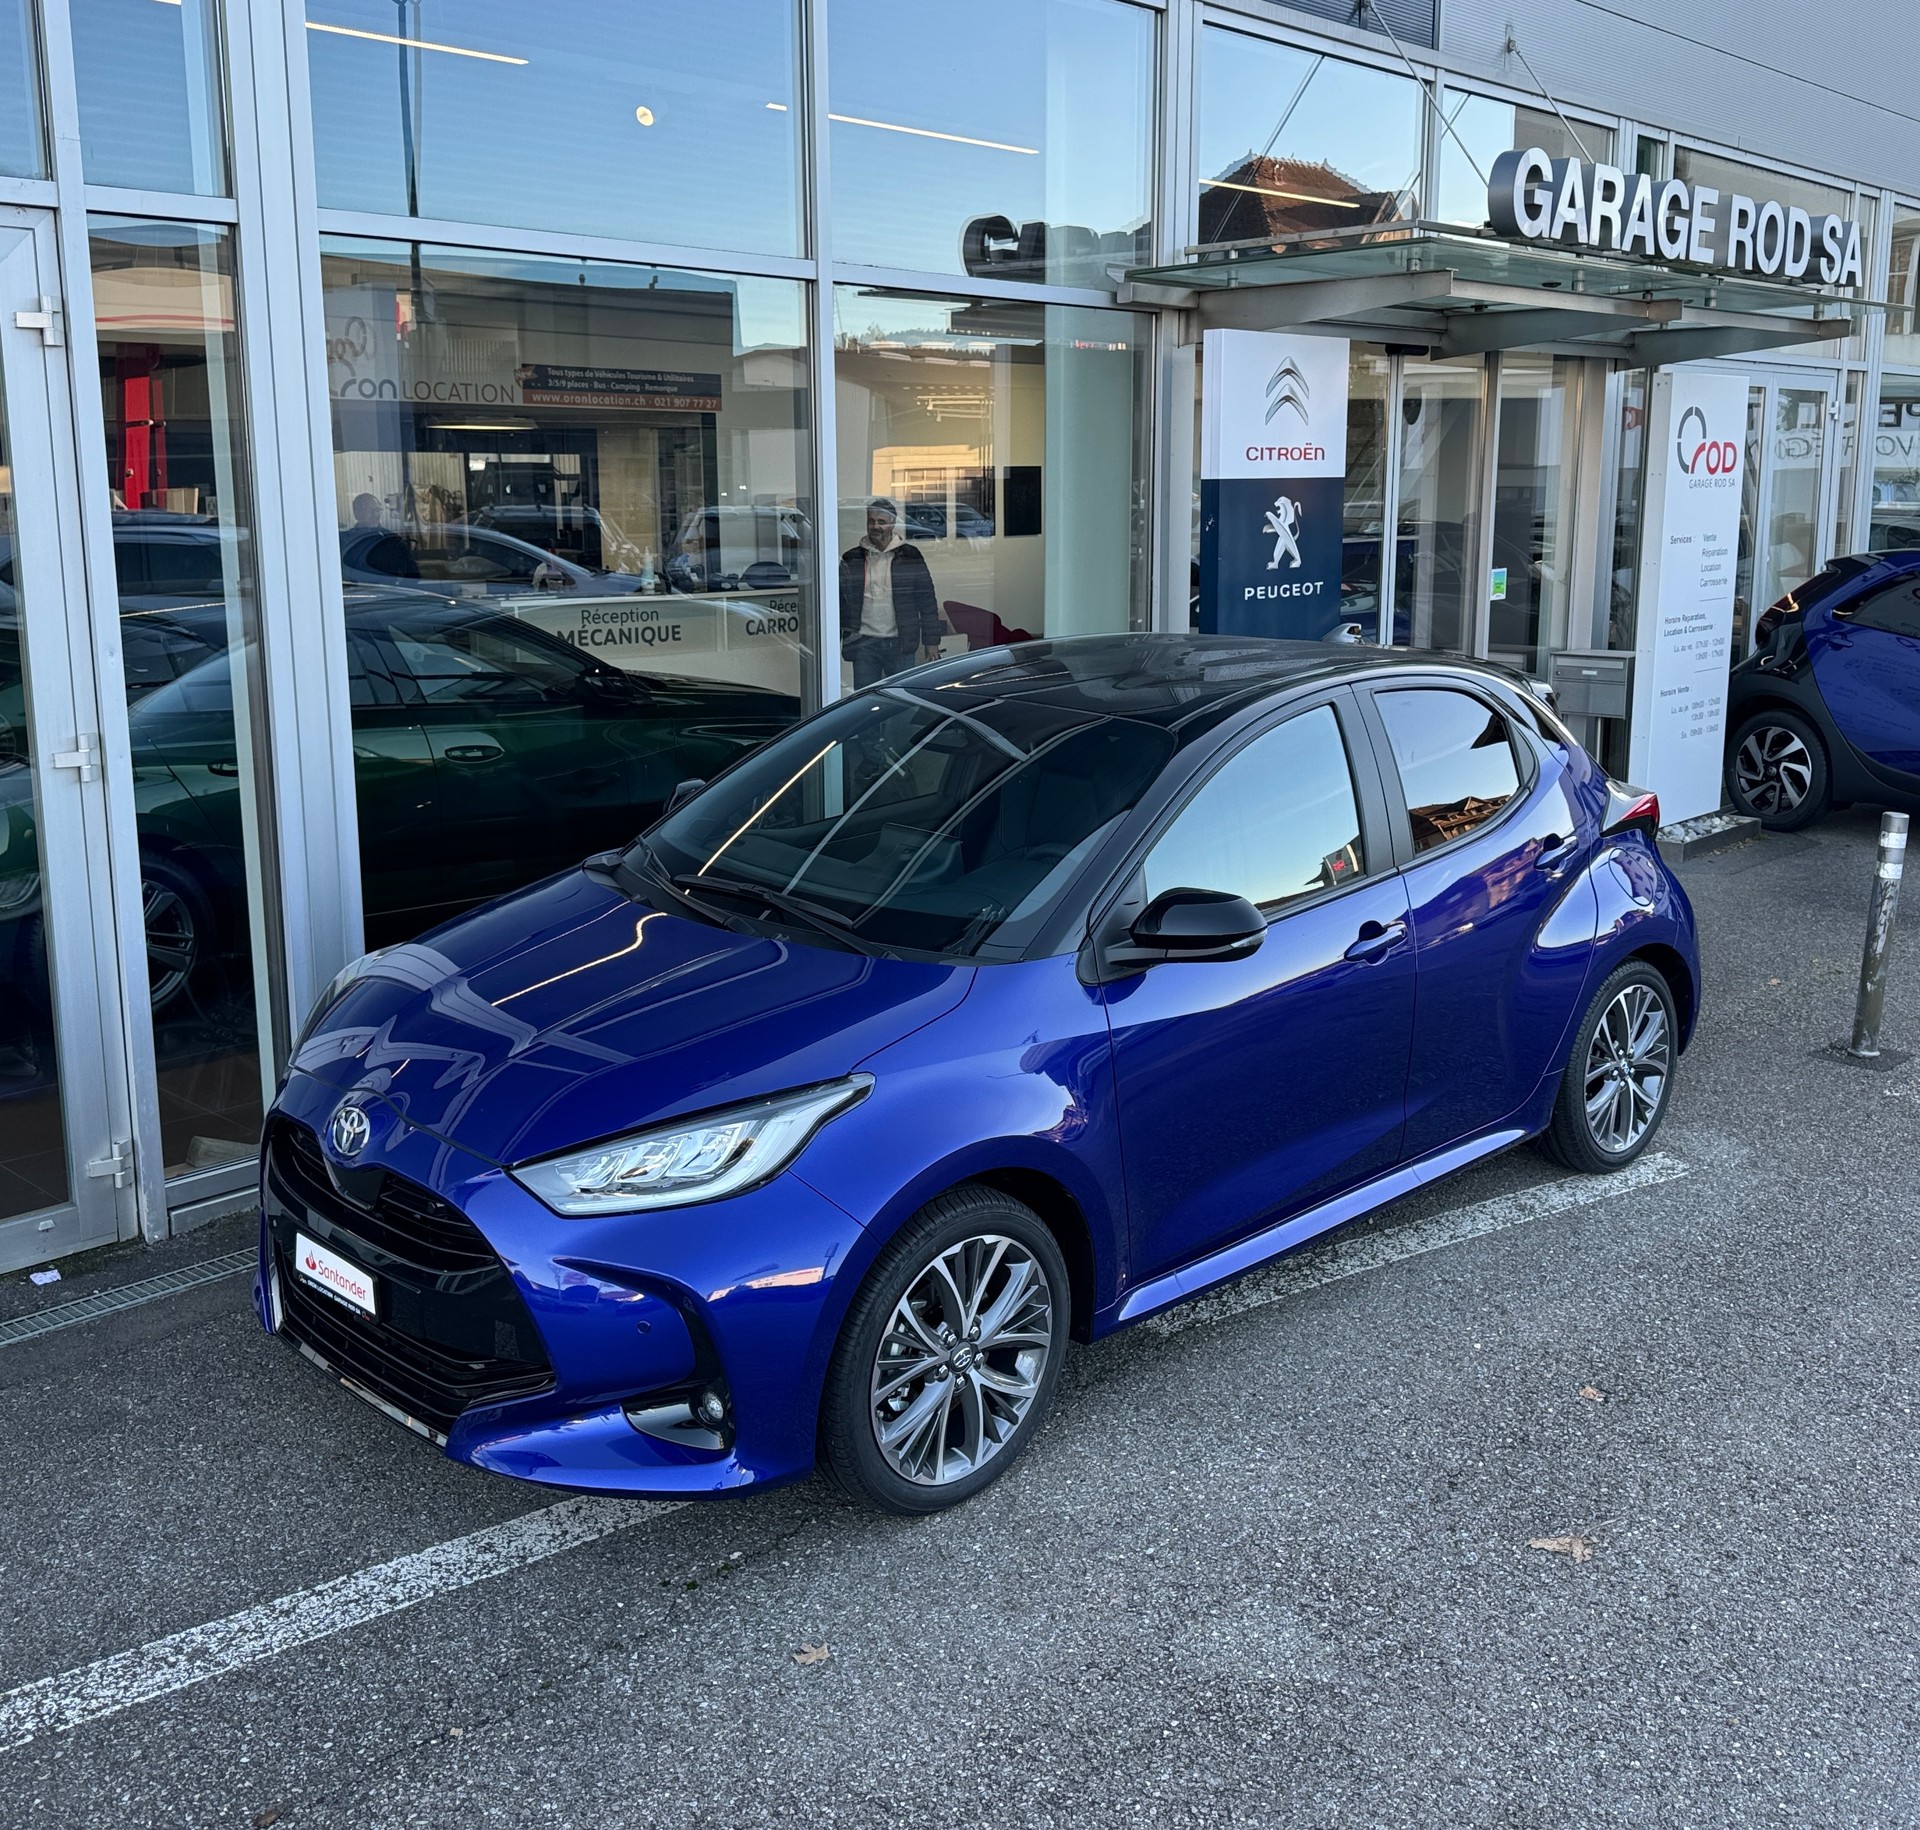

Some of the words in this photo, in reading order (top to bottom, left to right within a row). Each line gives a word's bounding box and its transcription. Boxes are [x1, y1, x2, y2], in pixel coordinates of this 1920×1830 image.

[1512, 147, 1720, 264] GARAGE
[1728, 194, 1812, 277] ROD
[1819, 214, 1863, 287] SA
[547, 368, 564, 377] Tous
[564, 369, 584, 379] types
[584, 370, 594, 378] de
[627, 372, 656, 381] Tourisme
[663, 373, 695, 383] Utilitaires
[403, 380, 515, 403] LOCATION
[567, 379, 589, 390] places
[594, 382, 607, 390] Bus
[611, 382, 641, 392] Camping
[645, 384, 678, 394] Remorque
[532, 393, 646, 406] www.oronlocation.ch
[654, 398, 671, 407] 021
[674, 399, 690, 409] 907
[693, 399, 704, 408] 77
[705, 400, 717, 409] 27
[1246, 442, 1325, 461] CITROËN
[1688, 478, 1713, 489] GARAGE
[1714, 478, 1727, 488] ROD
[1728, 478, 1736, 487] SA
[1670, 535, 1693, 545] Services
[1703, 533, 1717, 542] Vente
[1700, 563, 1722, 573] Location
[1699, 576, 1728, 588] Carrosserie
[1244, 582, 1324, 600] PEUGEOT
[769, 600, 799, 614] Réce
[581, 608, 659, 625] Réception
[1664, 616, 1681, 625] Horaire
[557, 624, 682, 647] MÉCANIQUE
[1663, 627, 1684, 637] Location
[1688, 623, 1713, 634] Carrosserie
[1660, 688, 1677, 698] Horaire
[1677, 686, 1690, 695] Vente
[318, 1259, 367, 1301] Santander
